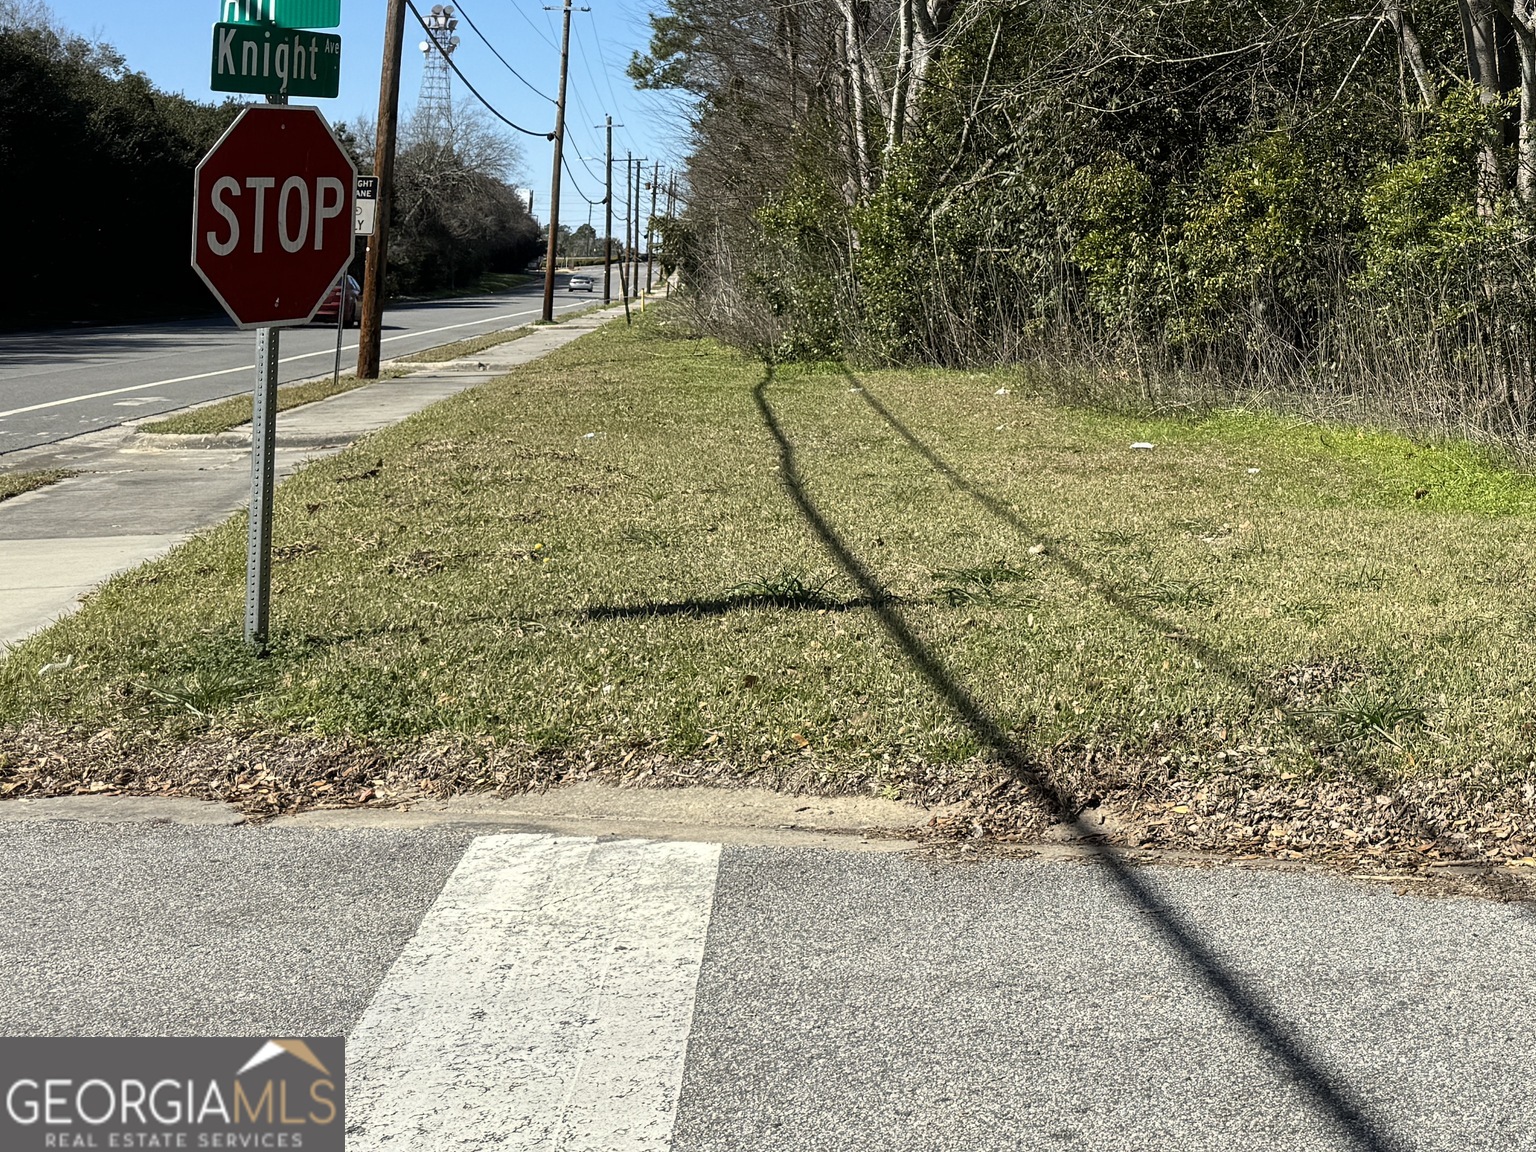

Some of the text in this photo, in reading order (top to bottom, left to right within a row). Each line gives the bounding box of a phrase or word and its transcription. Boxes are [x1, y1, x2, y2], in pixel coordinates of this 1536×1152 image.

[217, 27, 340, 94] Knight Ave
[356, 190, 372, 198] ANE
[357, 180, 373, 188] GHT
[206, 175, 345, 257] STOP
